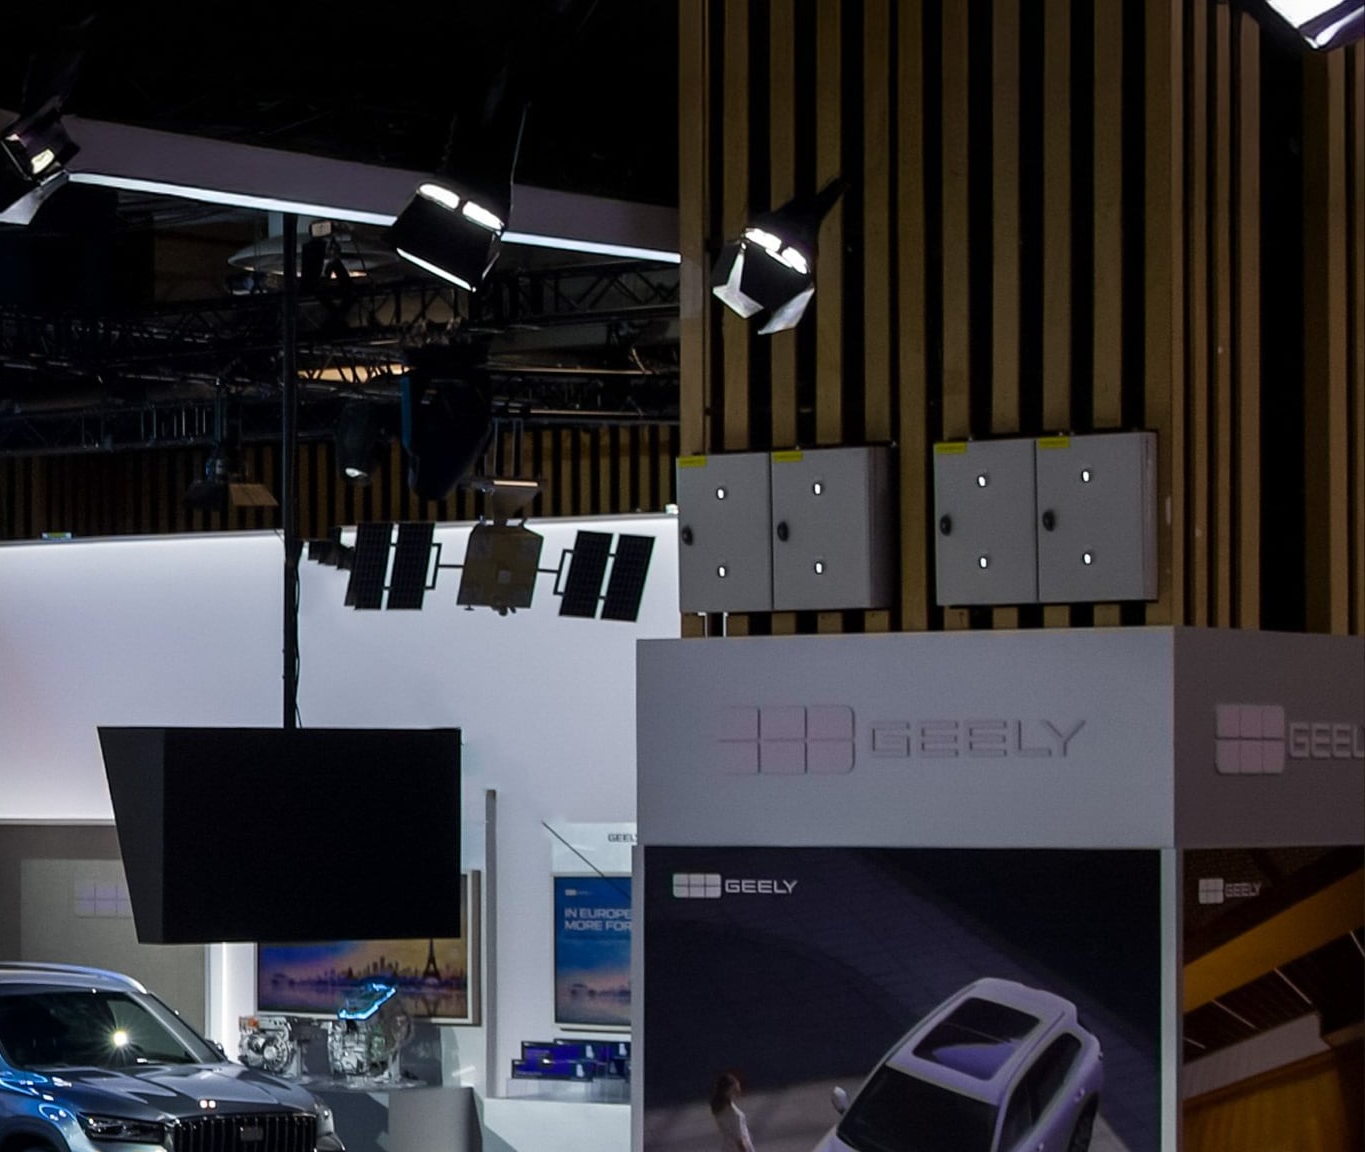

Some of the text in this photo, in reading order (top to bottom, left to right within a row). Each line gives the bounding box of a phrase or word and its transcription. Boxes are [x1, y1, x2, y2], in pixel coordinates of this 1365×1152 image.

[871, 719, 1086, 758] GEELY
[608, 833, 637, 843] GEEL
[725, 880, 798, 895] GEELY
[1225, 882, 1262, 898] GEELY
[565, 908, 577, 918] IN
[565, 920, 603, 931] MORE
